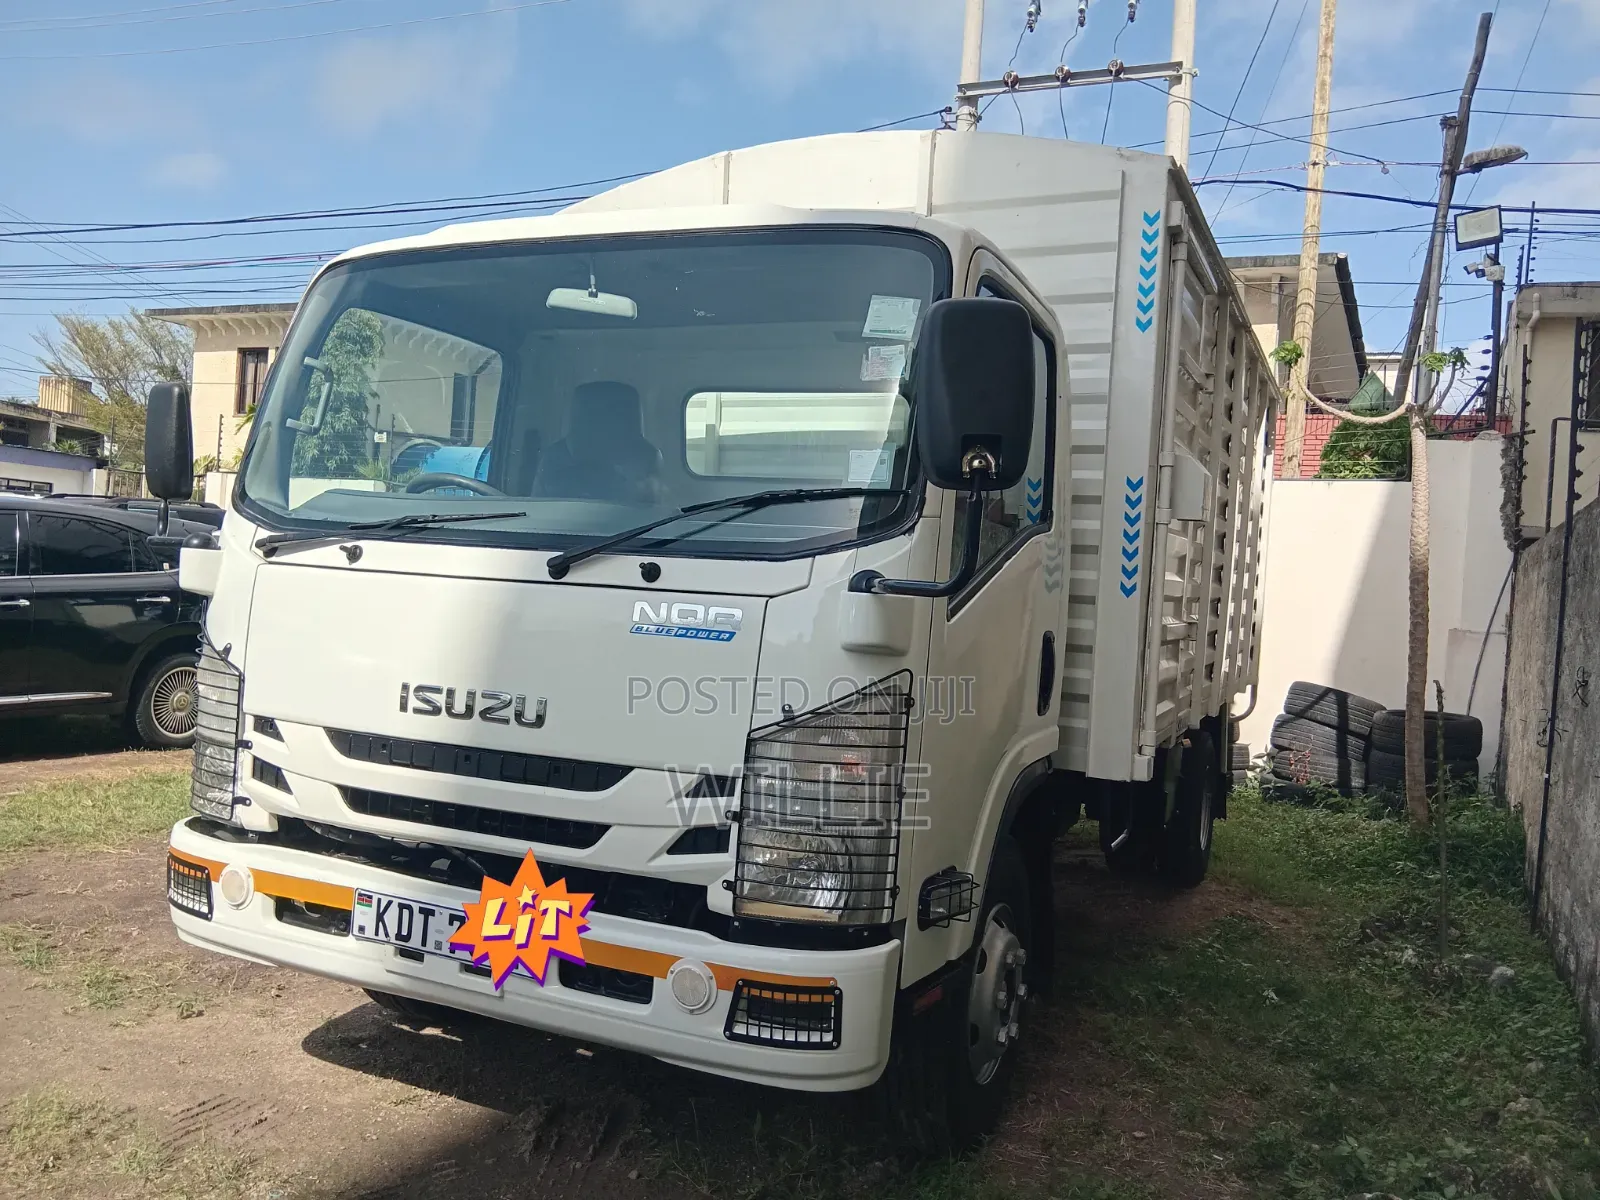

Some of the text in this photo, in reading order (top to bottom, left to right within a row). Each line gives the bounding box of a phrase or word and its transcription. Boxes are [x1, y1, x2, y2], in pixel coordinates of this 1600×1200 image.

[631, 600, 743, 632] NQR
[399, 681, 548, 729] ISUZU
[374, 897, 436, 948] KDT
